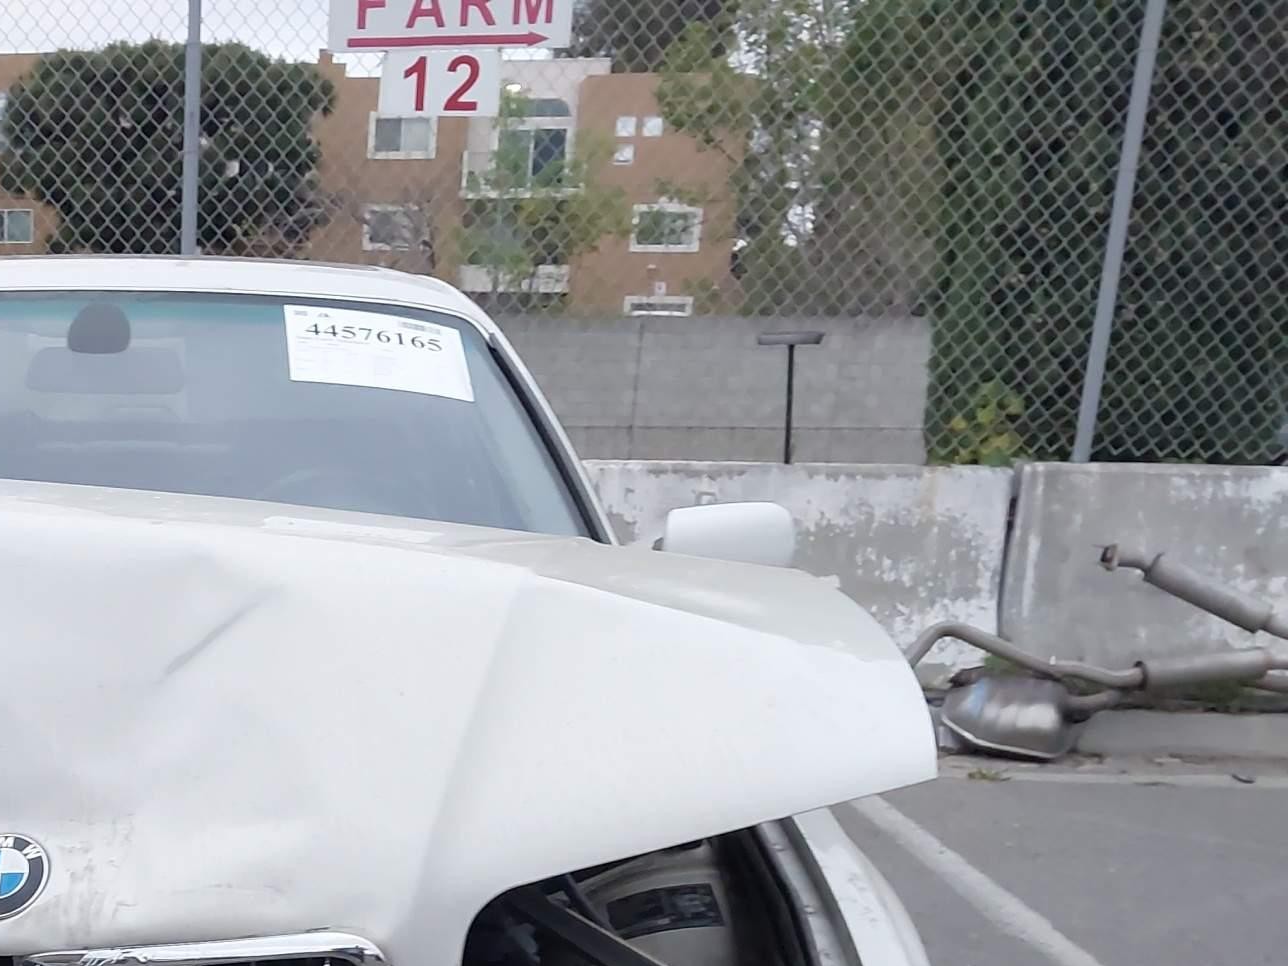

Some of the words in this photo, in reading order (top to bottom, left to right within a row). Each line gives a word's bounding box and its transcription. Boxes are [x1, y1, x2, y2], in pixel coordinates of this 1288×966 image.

[356, 0, 554, 29] FARM
[403, 55, 480, 111] 12
[305, 323, 443, 352] 44576165
